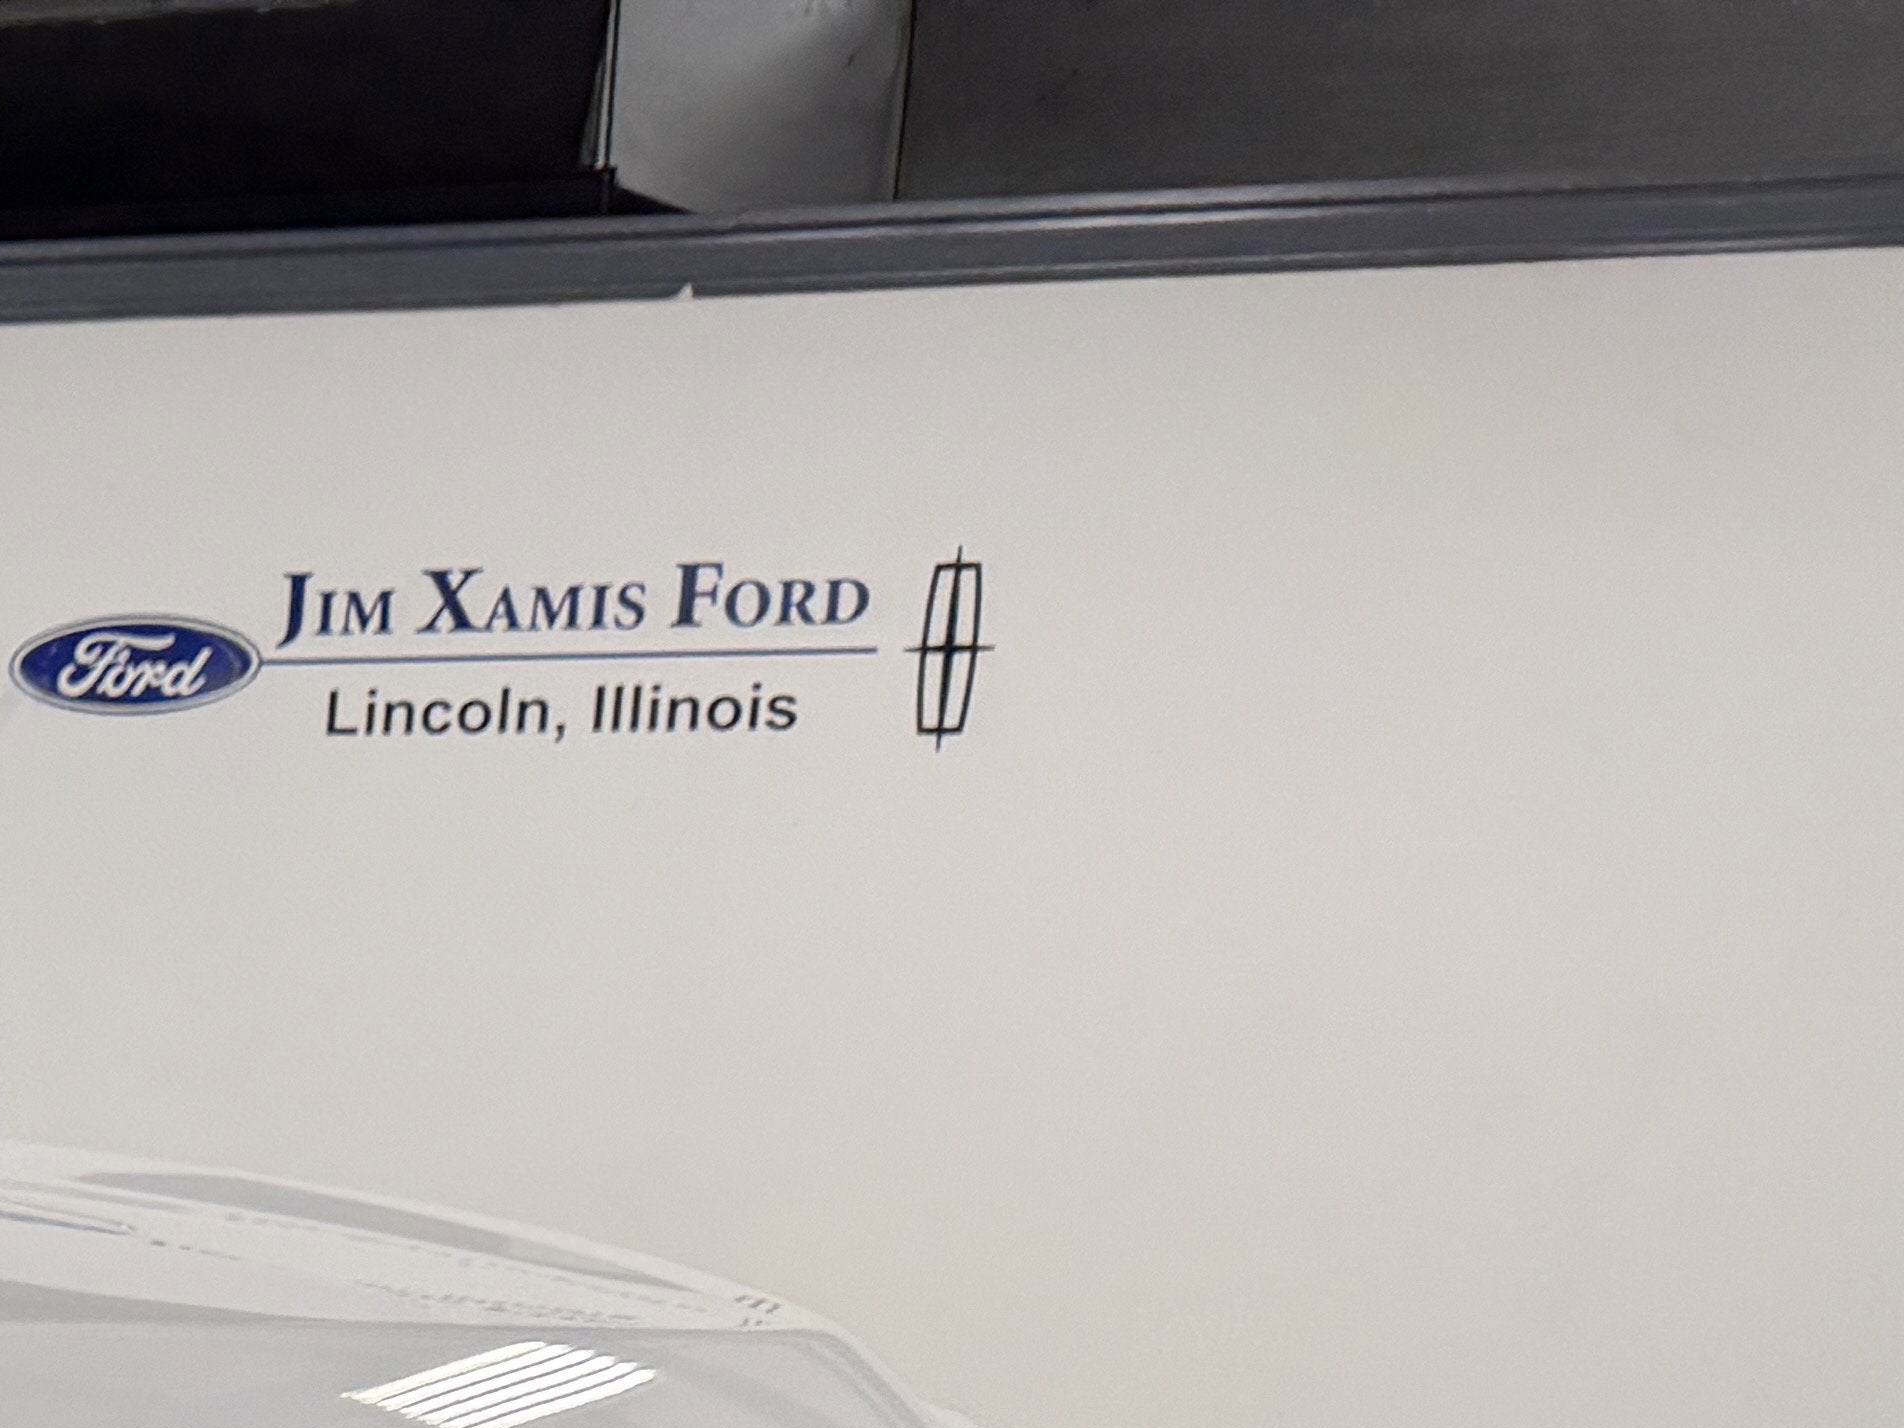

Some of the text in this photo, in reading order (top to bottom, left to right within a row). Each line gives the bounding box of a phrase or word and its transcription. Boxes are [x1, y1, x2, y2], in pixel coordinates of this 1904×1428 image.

[275, 561, 871, 649] JIM XAMIS FORD
[56, 632, 210, 698] Ford
[326, 682, 799, 743] Lincoln, Illinois
